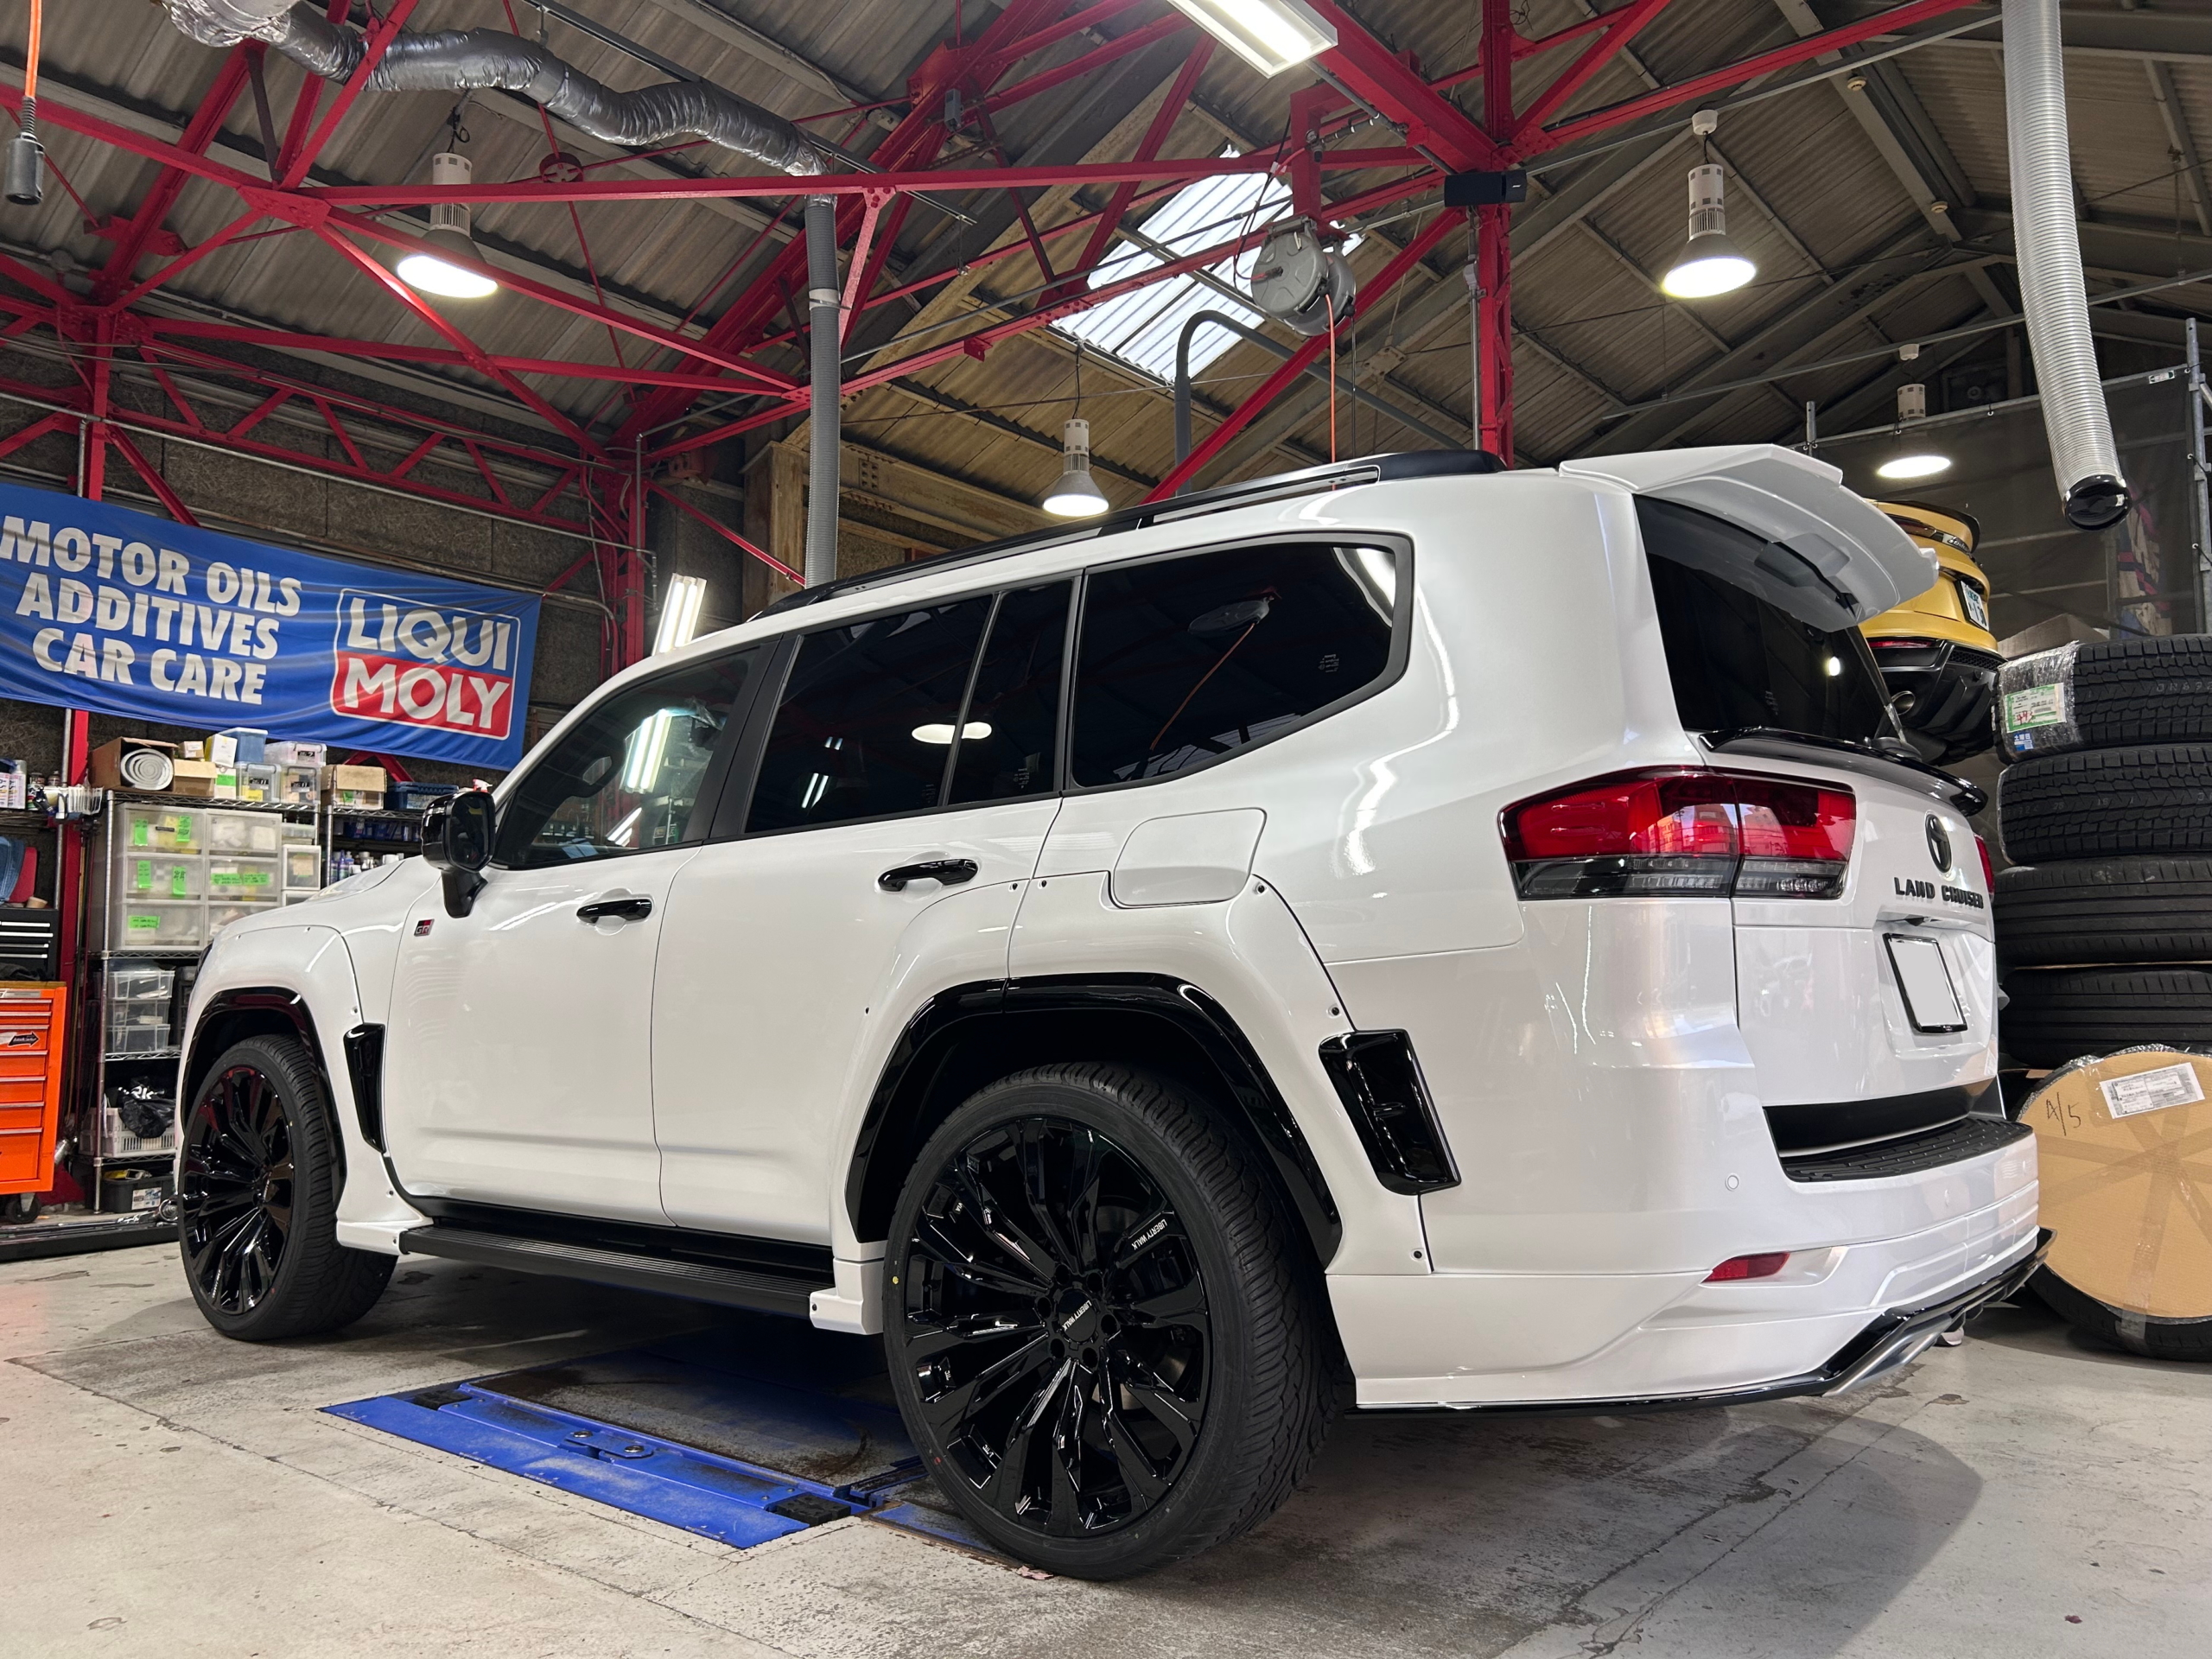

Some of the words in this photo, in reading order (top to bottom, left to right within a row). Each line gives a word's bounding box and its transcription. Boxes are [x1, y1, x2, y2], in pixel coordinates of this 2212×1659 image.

[0, 515, 189, 595] MOTOR
[207, 562, 302, 618] OILS
[16, 572, 279, 660] ADDITIVES
[347, 598, 512, 671] LIQUI
[33, 628, 136, 685] CAR
[149, 648, 268, 705] CARE
[344, 658, 510, 729] MOLY
[1894, 877, 1936, 899] LAND
[1131, 1234, 1147, 1250] WALK
[1146, 1218, 1167, 1240] LIBERTY
